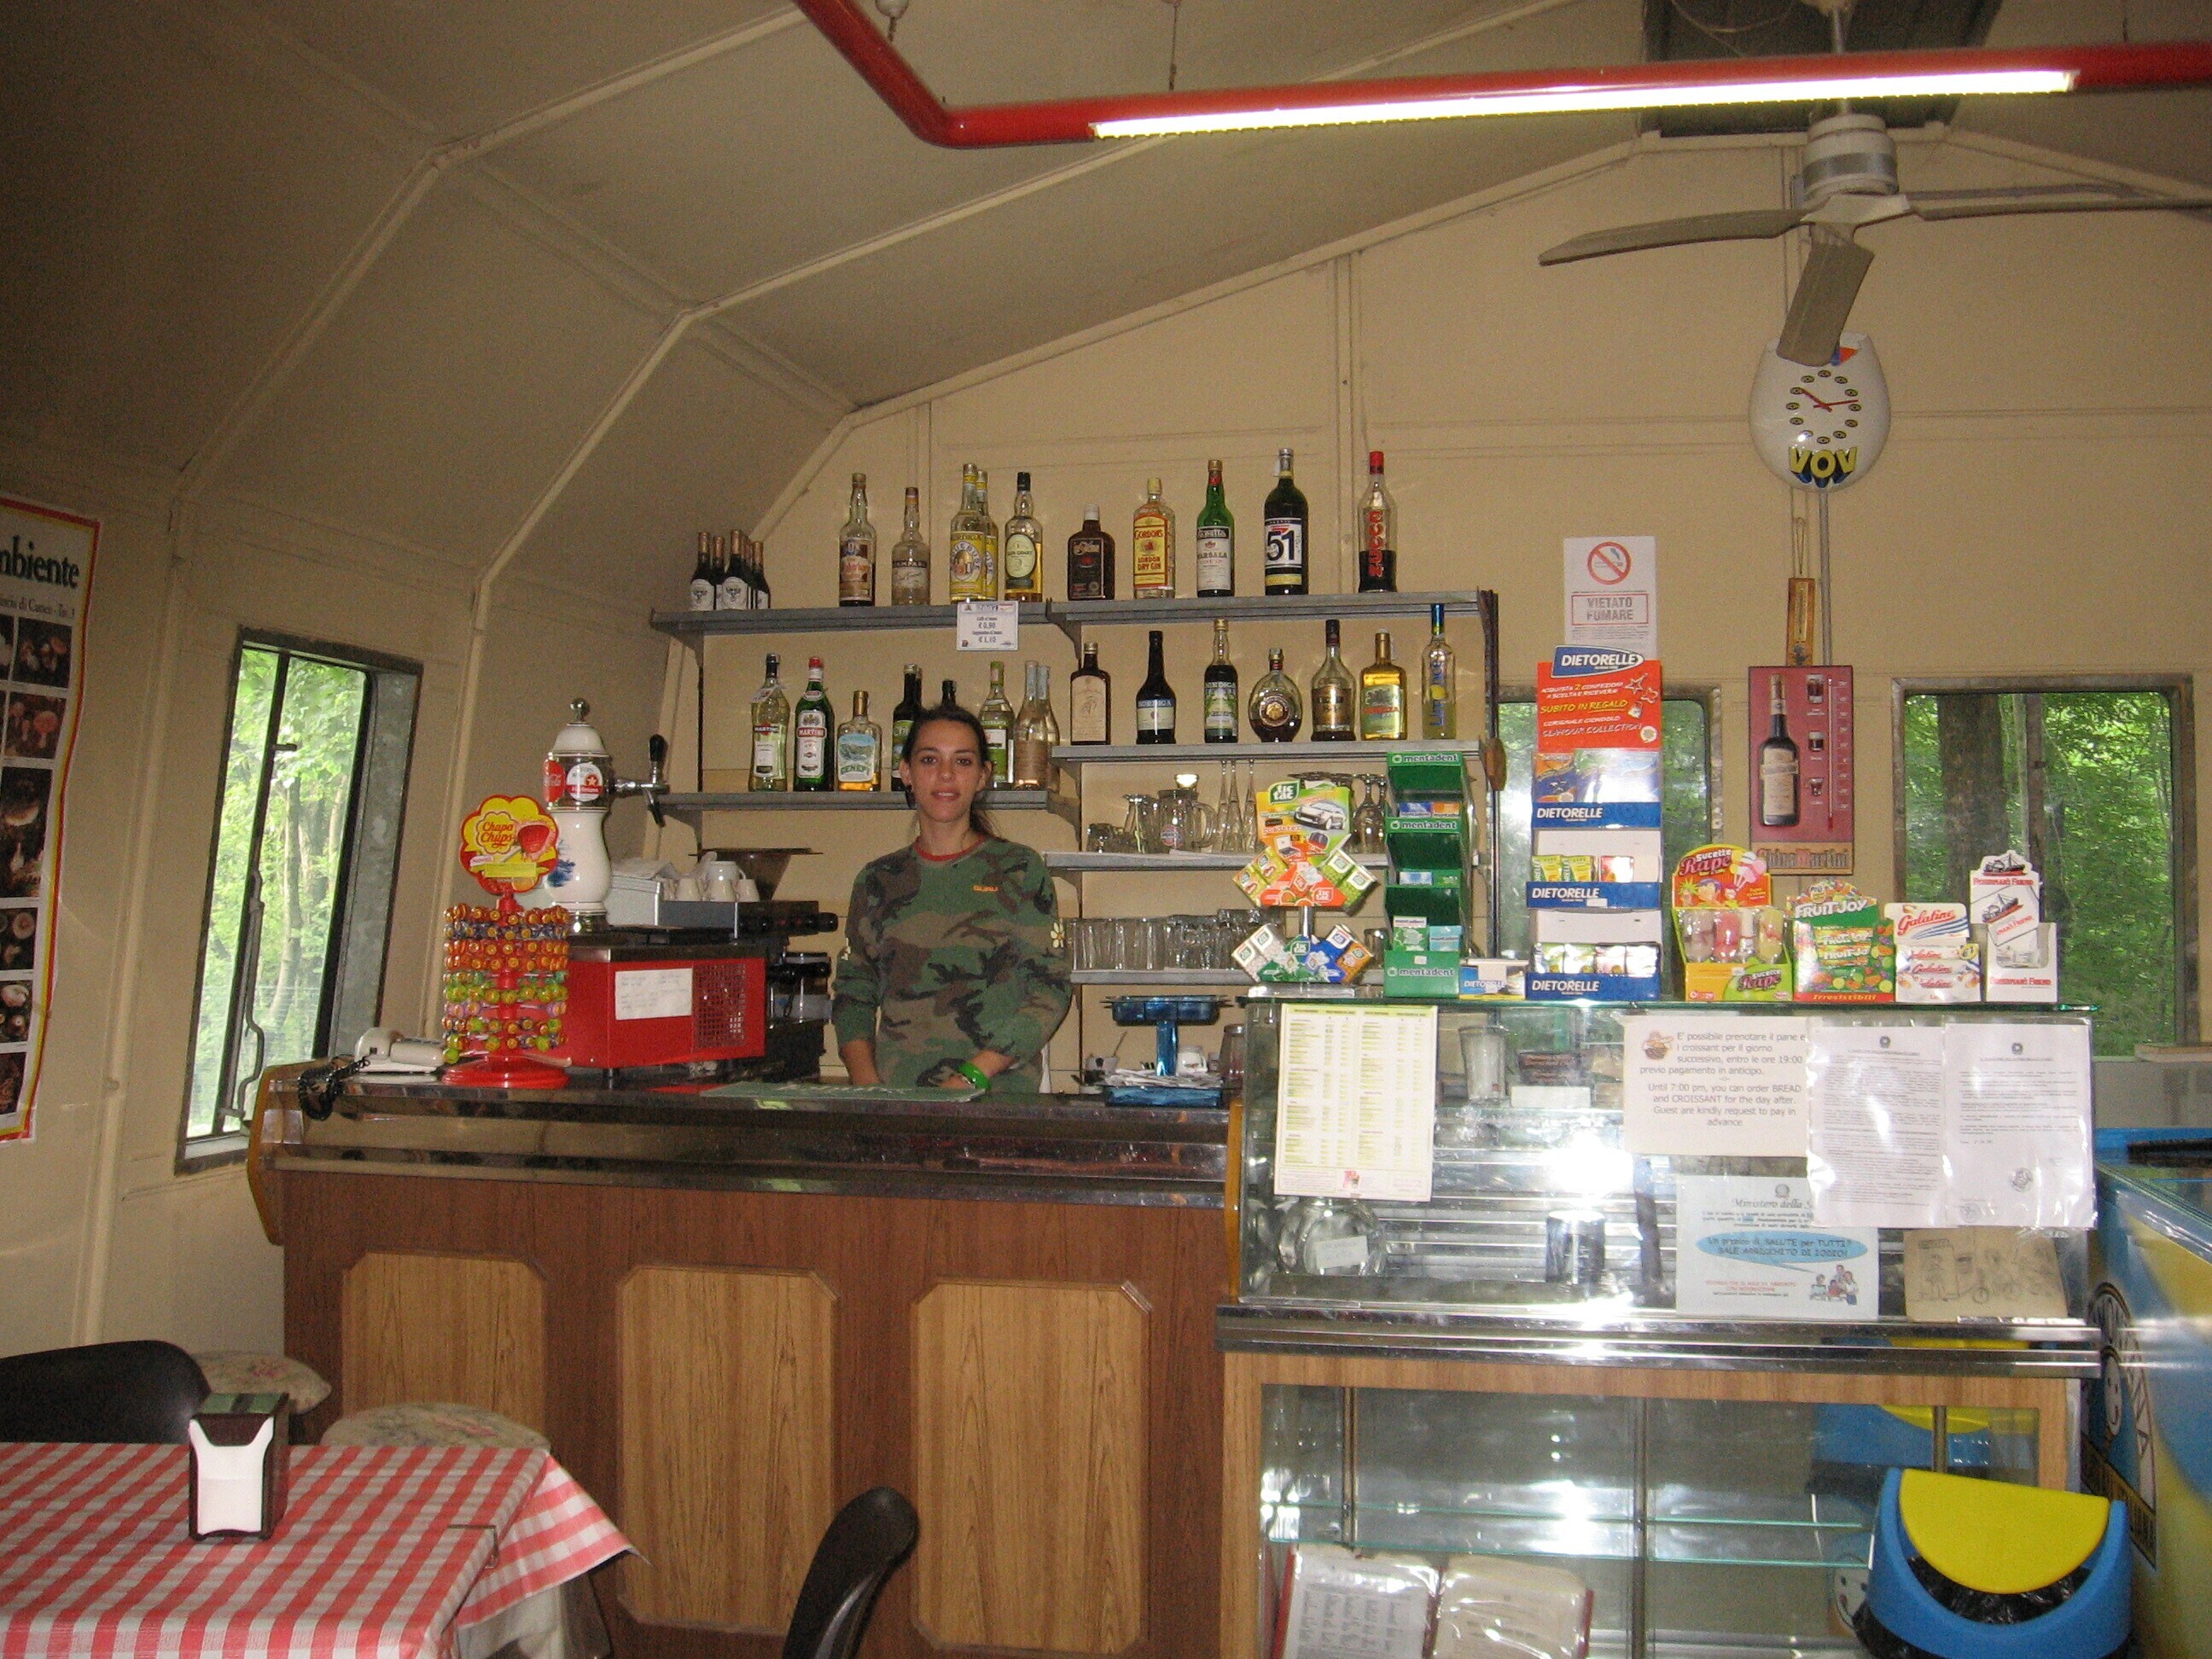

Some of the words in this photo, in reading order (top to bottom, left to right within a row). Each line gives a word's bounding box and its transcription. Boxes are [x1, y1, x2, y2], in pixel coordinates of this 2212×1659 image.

[1789, 446, 1858, 480] VOV
[1267, 531, 1295, 561] 51
[1586, 597, 1633, 608] VIETATO
[1586, 609, 1633, 620] FUMARE
[1561, 654, 1636, 667] DIETORELLE
[1540, 703, 1575, 713] SUBITO
[1578, 702, 1587, 711] IN
[1589, 700, 1627, 710] REGALO
[1586, 722, 1642, 734] COLLECTION
[1404, 754, 1459, 762] mentadent
[1273, 792, 1294, 800] tac
[1537, 807, 1603, 818] DIETORELLE
[1401, 821, 1456, 830] mentadent
[480, 832, 515, 847] Chups
[1696, 849, 1732, 862] sucette
[1973, 877, 2011, 886] FISHERMAN'S
[1532, 888, 1599, 899] DIETORELLE
[1897, 910, 1955, 935] Galatine
[1398, 968, 1454, 977] mentadent
[1532, 980, 1600, 992] DIETORELLE
[2029, 977, 2052, 986] FRIEND
[1812, 992, 1877, 1001] Irresistibili
[1687, 1032, 1723, 1042] possibile
[1726, 1033, 1767, 1042] prenotare
[1776, 1033, 1797, 1042] pane
[1746, 1045, 1773, 1054] giorno
[1639, 1067, 1666, 1075] previo
[1668, 1067, 1715, 1076] pagamento
[1728, 1067, 1764, 1075] anticipo.
[1648, 1083, 1668, 1091] Until
[1670, 1083, 1689, 1091] 7:00
[1711, 1085, 1726, 1093] you
[1672, 1095, 1722, 1103] CROISSANT
[1755, 1096, 1770, 1104] day
[1653, 1106, 1678, 1115] Guest
[1697, 1106, 1722, 1116] kindly
[1725, 1107, 1755, 1116] request
[1770, 1108, 1785, 1116] pay
[1707, 1117, 1743, 1126] advance
[1733, 1198, 1778, 1208] Ministero
[1780, 1198, 1802, 1208] della
